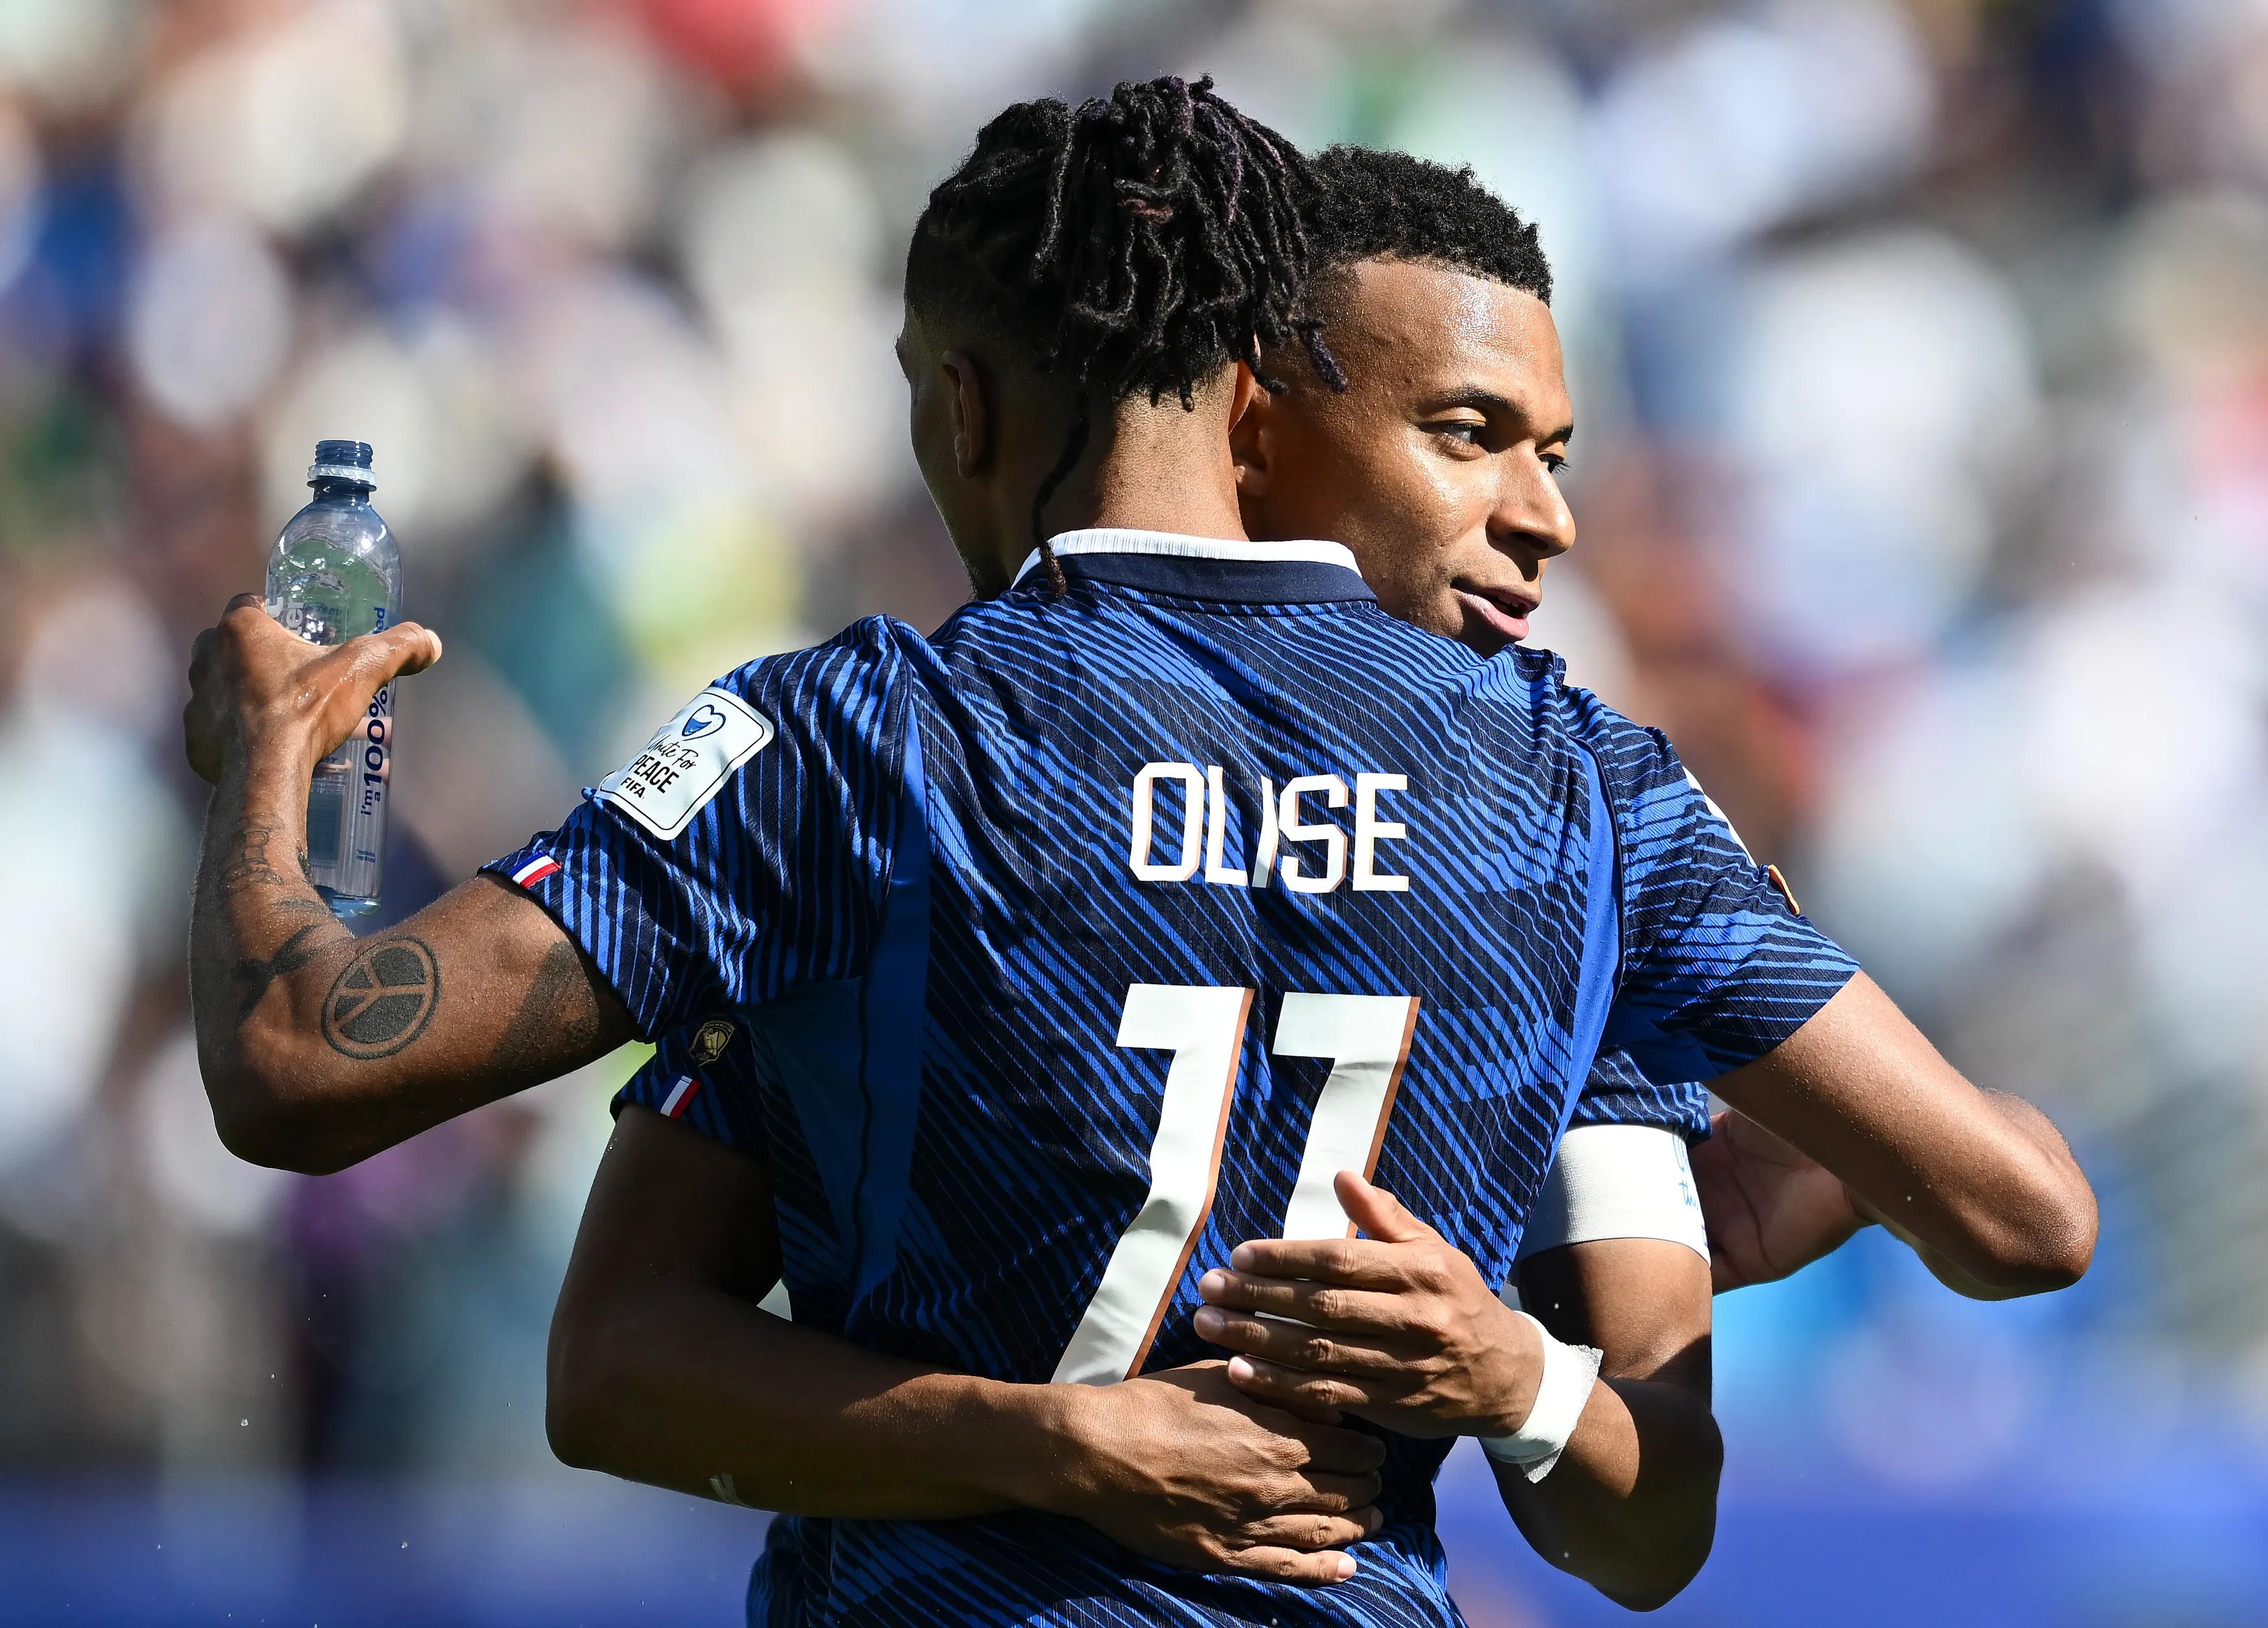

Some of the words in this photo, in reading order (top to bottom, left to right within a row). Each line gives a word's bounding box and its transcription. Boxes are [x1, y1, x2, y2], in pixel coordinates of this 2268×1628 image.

[364, 689, 388, 786] 100%
[647, 733, 680, 757] Unite
[671, 748, 699, 770] For
[620, 776, 646, 799] FIFA
[628, 753, 680, 794] PEACE
[373, 791, 381, 802] a
[1129, 761, 1409, 893] OLISE
